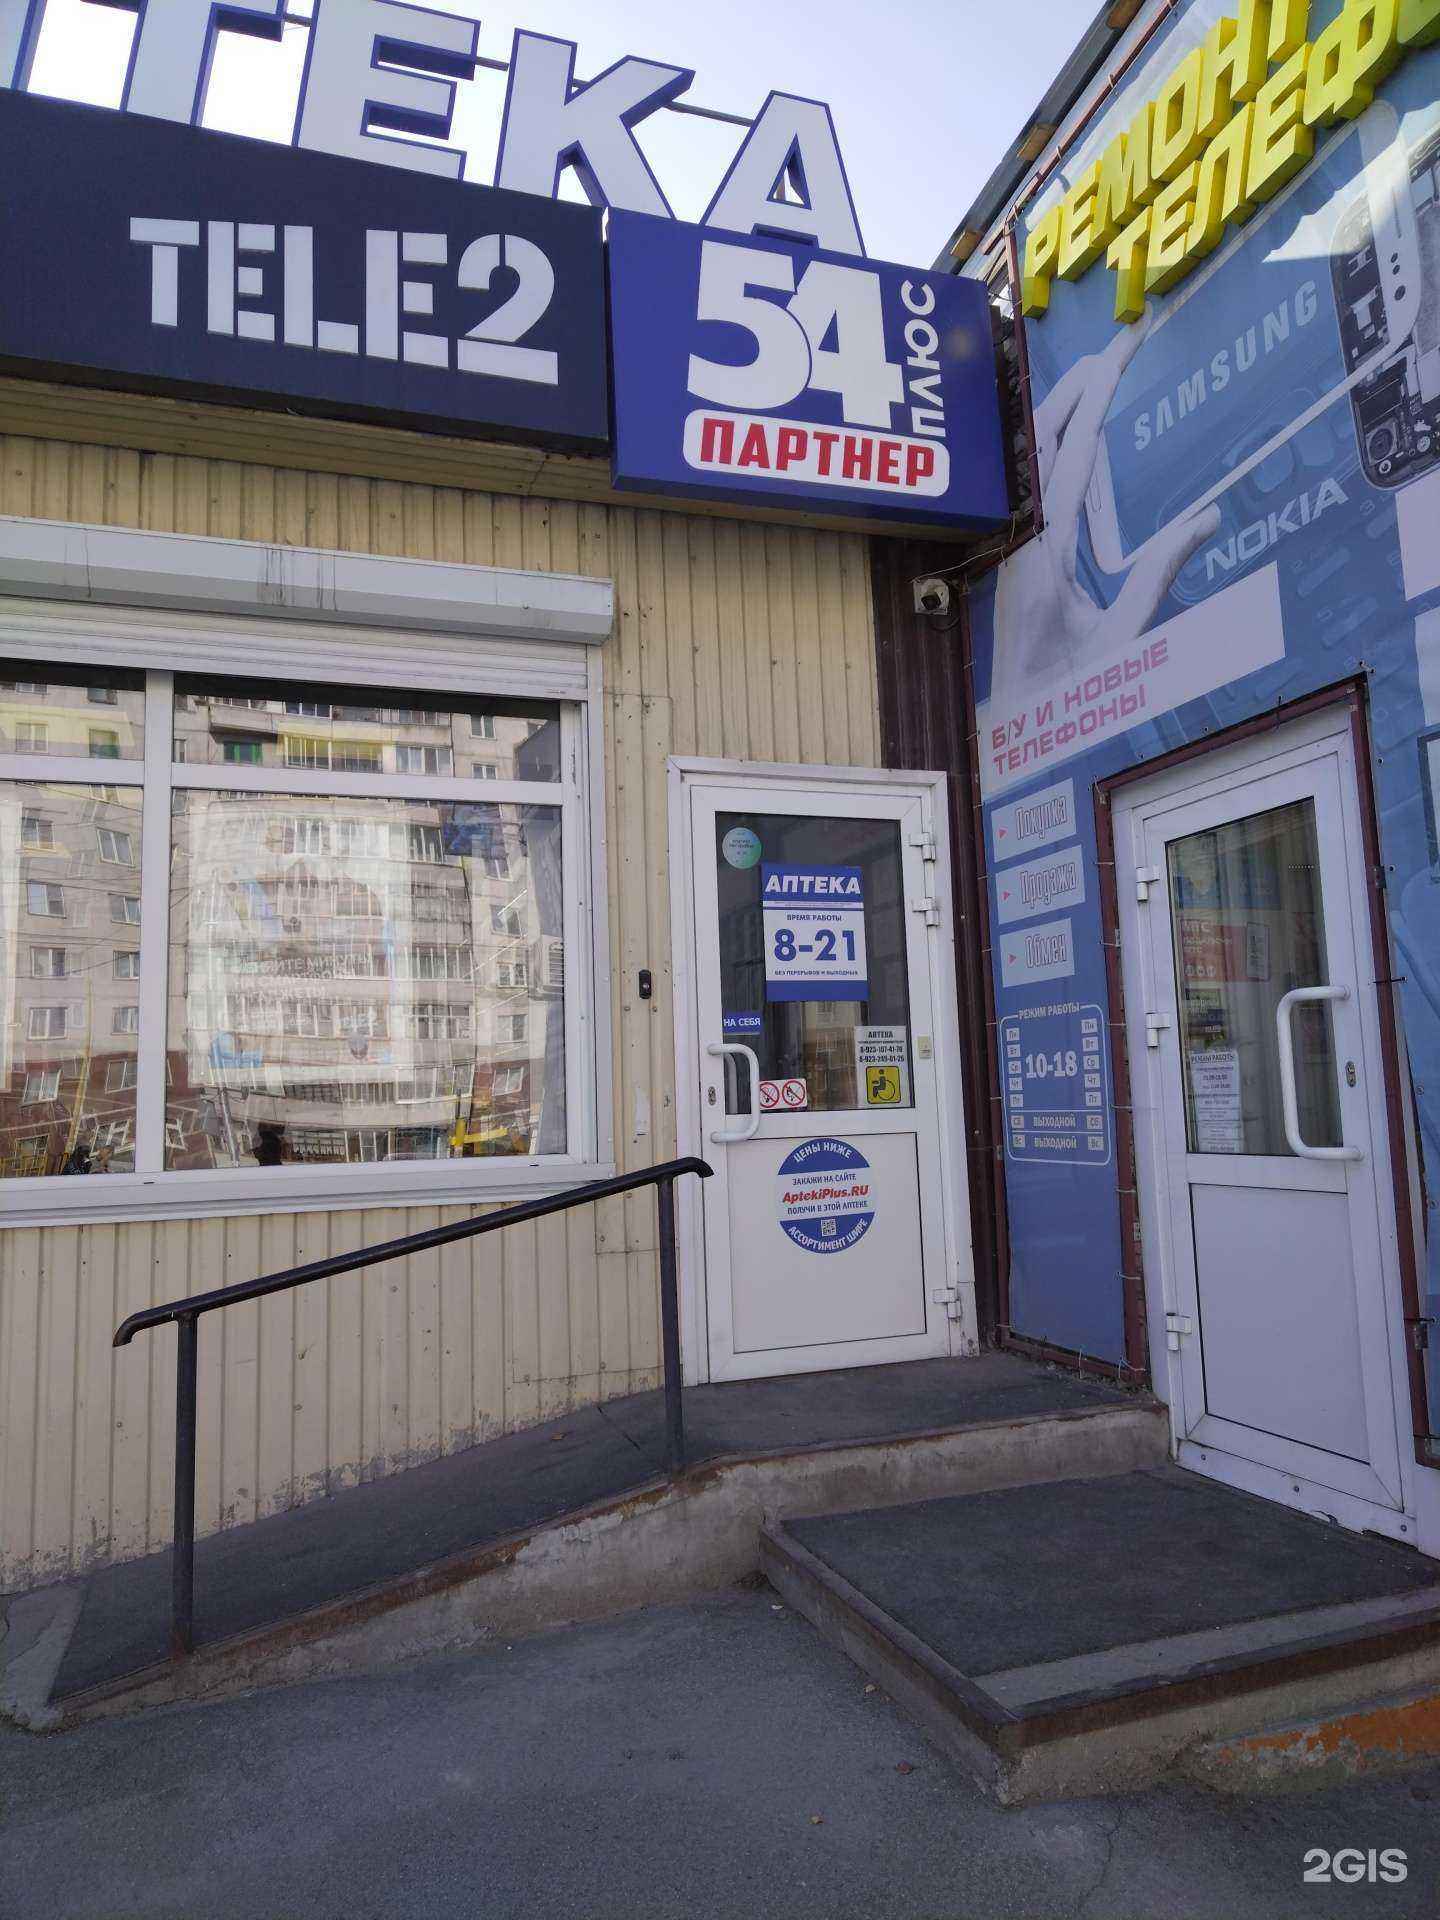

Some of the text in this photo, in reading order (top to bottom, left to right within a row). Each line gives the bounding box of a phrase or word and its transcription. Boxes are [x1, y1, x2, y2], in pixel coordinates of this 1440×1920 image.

[0, 0, 866, 259] ТЕКА
[130, 217, 558, 385] TELE2
[687, 240, 905, 429] 54
[900, 279, 946, 437] ПЛЮС
[1134, 280, 1318, 450] SAMSUNG
[700, 418, 935, 487] ПАРТНЕР
[1205, 478, 1349, 580] NOKIA
[991, 638, 1168, 749] Б/У И НОВЫЕ
[993, 684, 1147, 776] ТЕЛЕФОНЫ
[1015, 796, 1068, 840] Покупка
[765, 874, 861, 894] АПТЕКА
[1020, 862, 1077, 909] Продажа
[774, 928, 857, 962] 8-21
[1025, 935, 1066, 970] Обмен
[723, 1017, 761, 1027] НА СЕБЯ
[1018, 1002, 1080, 1020] РЕЖИМ РАБОТЫ
[1084, 1020, 1095, 1031] Пн
[868, 1031, 893, 1039] АПТЕКА
[1026, 1051, 1078, 1079] 10-18
[1087, 1075, 1097, 1085] Чт
[1033, 1114, 1076, 1128] ВЫХОДНОЙ
[793, 1142, 853, 1163] ЦЕНЫ НИЖЕ
[1034, 1135, 1077, 1149] ВЫХОДНОЙ
[782, 1184, 869, 1204] AptekiPlus.RU
[792, 1176, 823, 1186] ЗАКАЖИ
[835, 1173, 857, 1182] САЙТЕ
[787, 1205, 816, 1215] ПОЛУЧИ
[823, 1201, 841, 1212] ЭТОЙ
[842, 1200, 869, 1210] АПТЕКЕ
[788, 1218, 869, 1251] АССОРТИМЕНТ ШИРЕ
